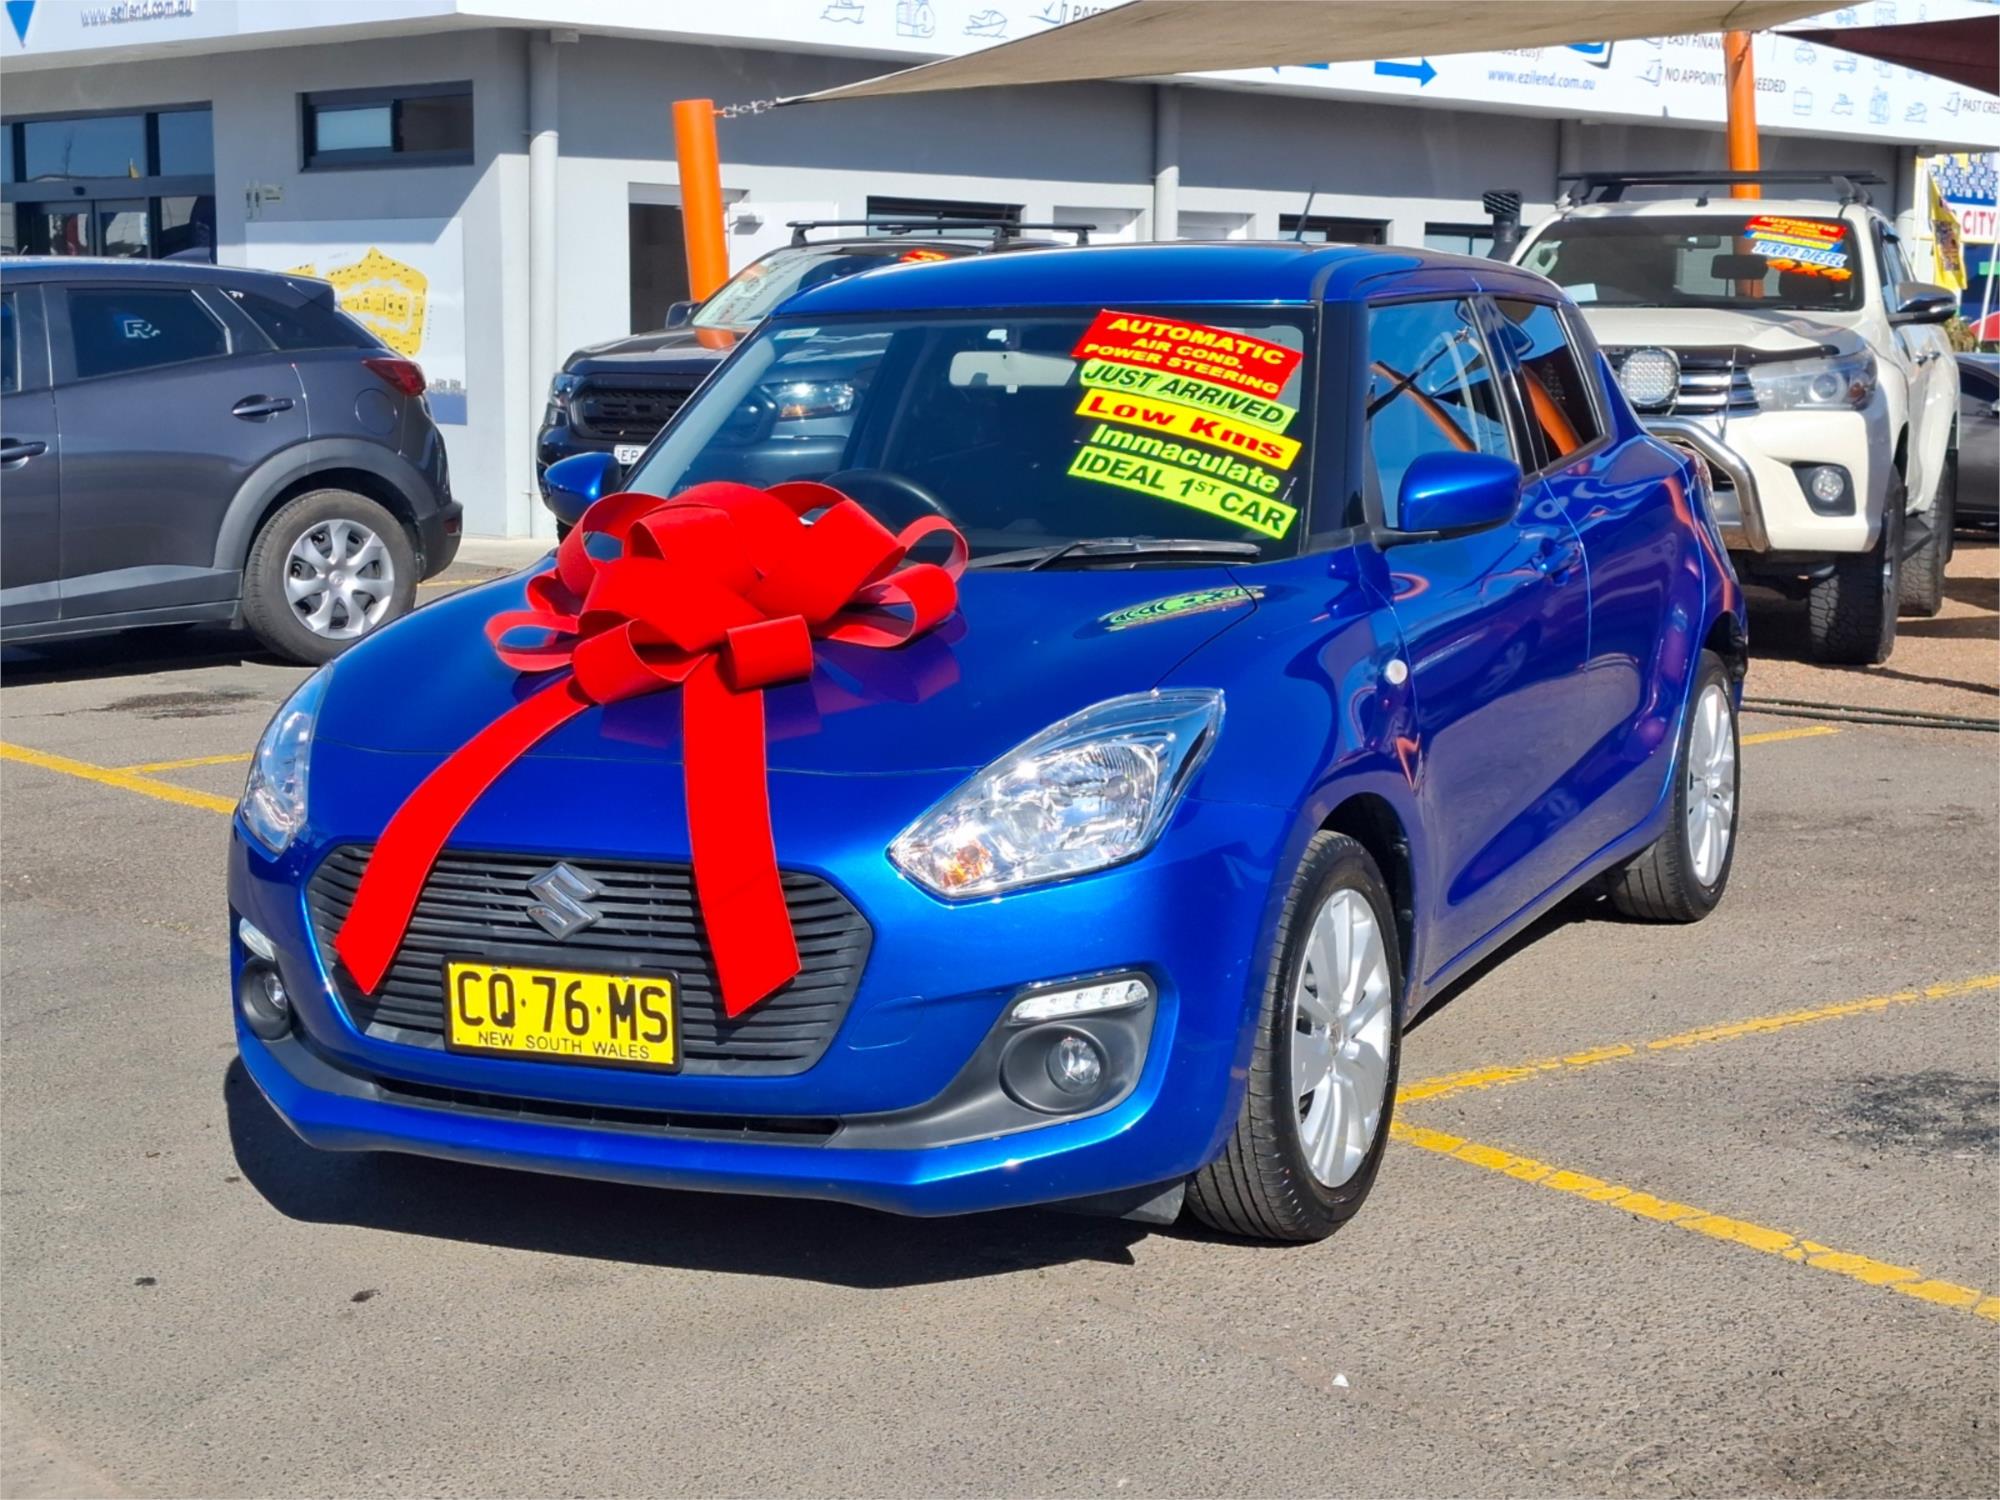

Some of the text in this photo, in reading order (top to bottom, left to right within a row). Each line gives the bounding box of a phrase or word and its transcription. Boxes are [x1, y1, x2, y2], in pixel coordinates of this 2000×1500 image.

[1692, 36, 1721, 49] FINAN
[1665, 67, 1680, 82] NO
[1682, 69, 1725, 87] APPOINT
[1962, 211, 1997, 236] CITY
[1757, 241, 1799, 257] TURBO
[1800, 248, 1846, 267] DIESEL
[1107, 318, 1285, 364] AUTOMATIC
[1132, 338, 1244, 370] AIR COND.
[1084, 343, 1280, 394] POWER STEERING
[1083, 364, 1285, 422] JUST ARRIVED
[1189, 417, 1284, 460] Kms
[621, 449, 638, 462] EP
[1090, 424, 1280, 493] Immaculate
[1076, 451, 1166, 491] IDEAL
[1220, 492, 1287, 531] CAR
[478, 1031, 650, 1060] NEW SOUTH WALES
